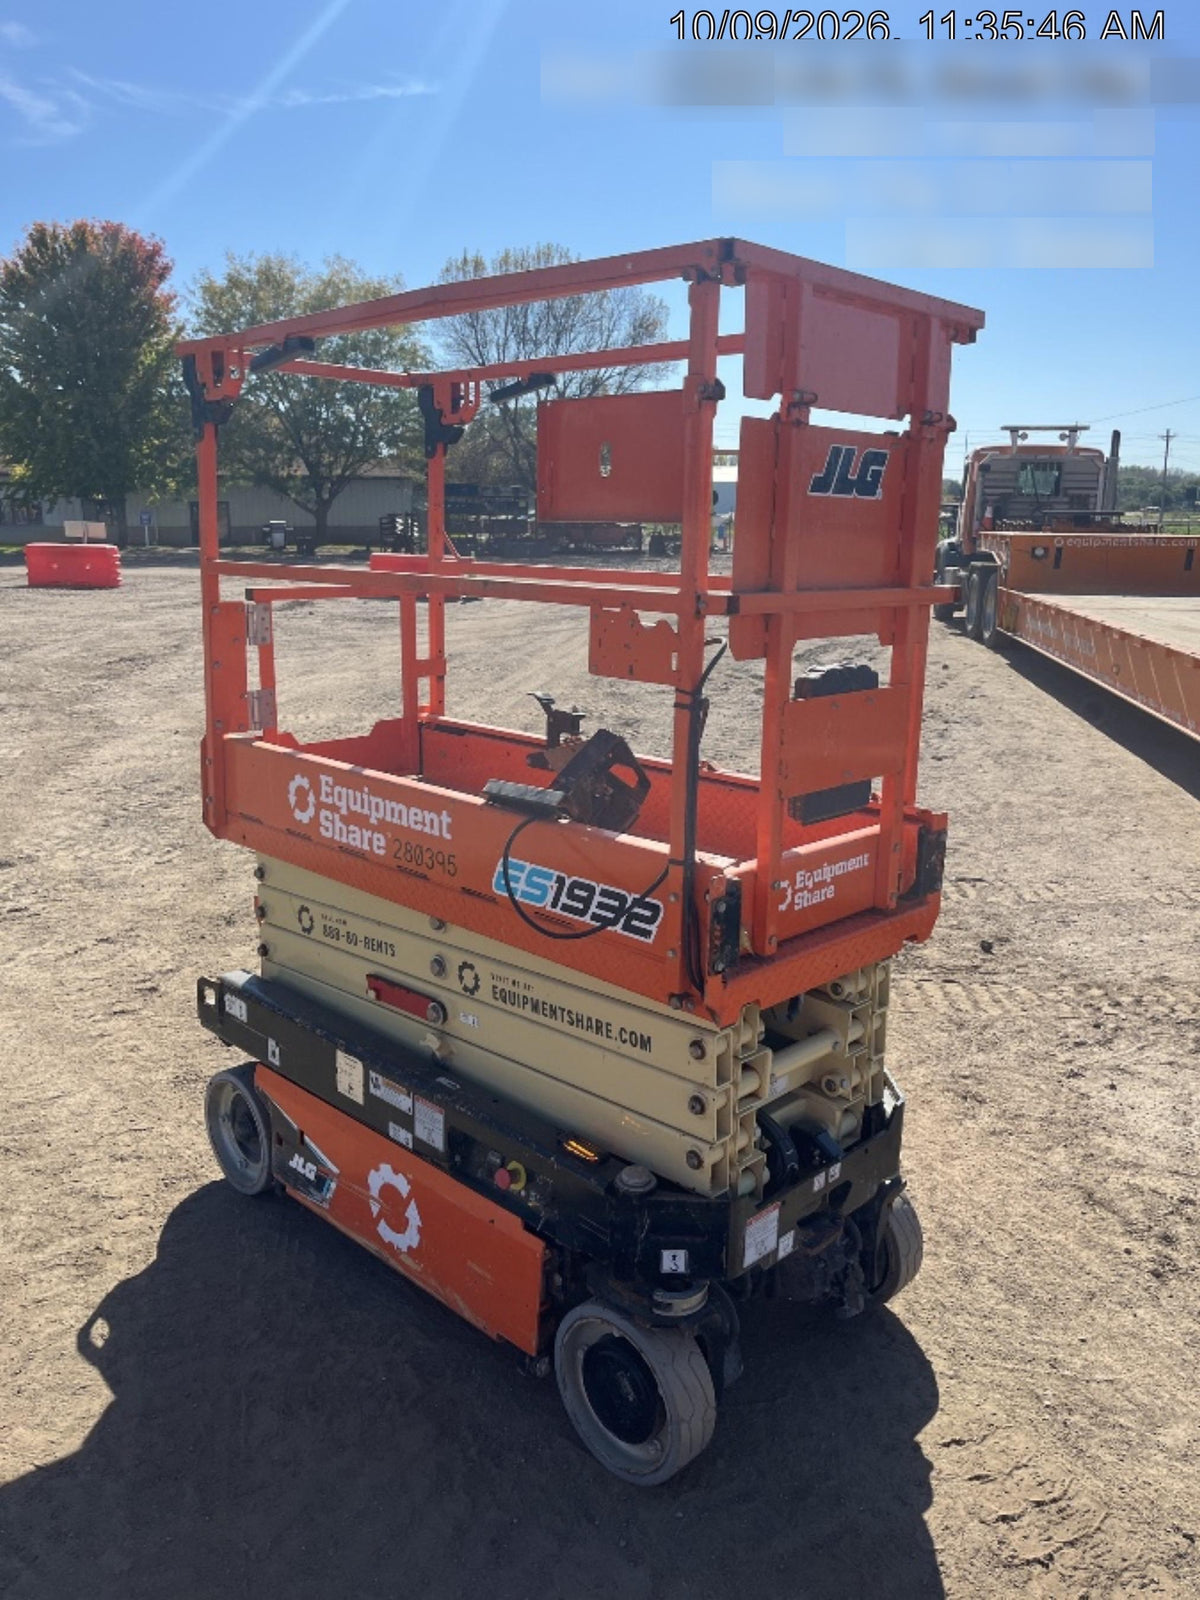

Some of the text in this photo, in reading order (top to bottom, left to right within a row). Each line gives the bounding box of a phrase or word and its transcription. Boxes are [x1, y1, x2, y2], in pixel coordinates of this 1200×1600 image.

[807, 444, 890, 500] JLG
[319, 774, 452, 840] Equipment
[319, 809, 388, 855] Share
[393, 838, 458, 877] 280395
[795, 852, 870, 890] Equipment
[493, 857, 663, 943] ES1932
[794, 885, 835, 911] Share
[492, 985, 652, 1053] EQUIPMENTSHARE.COM
[289, 1153, 317, 1181] JLG
